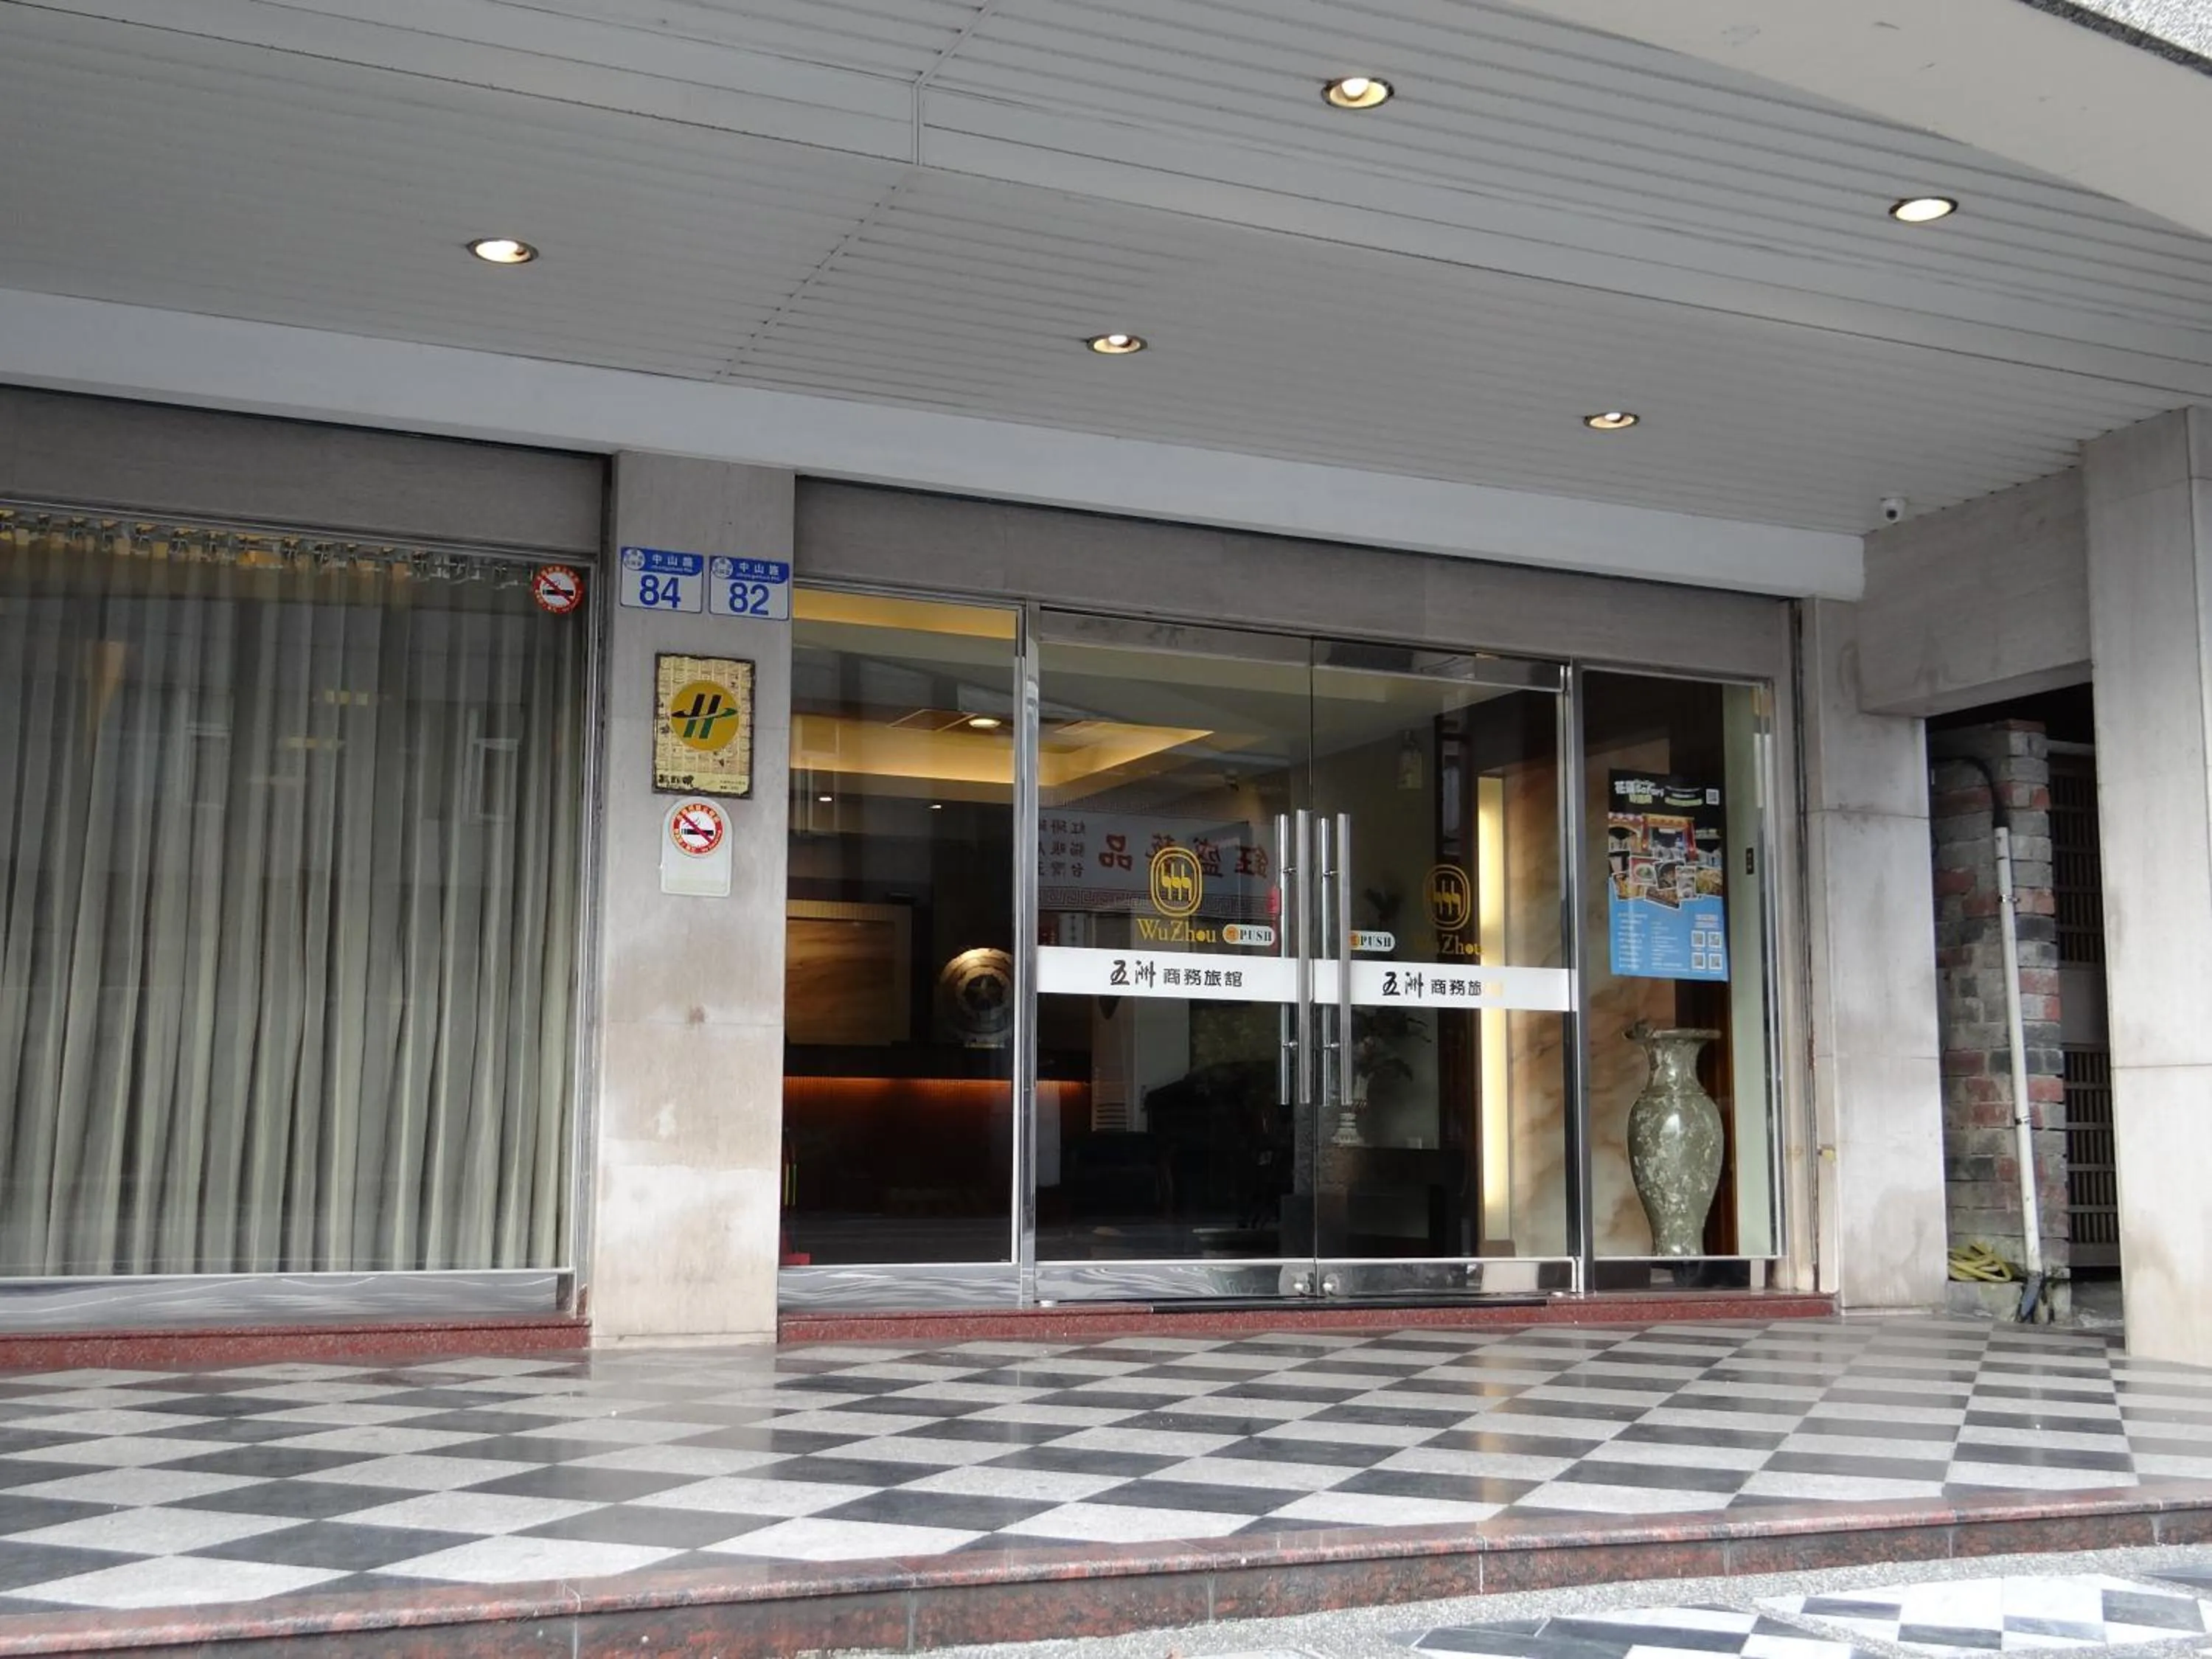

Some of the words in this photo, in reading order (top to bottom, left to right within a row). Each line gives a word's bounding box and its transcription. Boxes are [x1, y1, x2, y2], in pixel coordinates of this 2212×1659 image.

[652, 554, 693, 567] 中山路
[739, 561, 779, 575] 中山路
[639, 574, 681, 608] 84
[729, 582, 770, 615] 82
[1136, 918, 1216, 943] WuZhou
[1240, 928, 1272, 942] PUSH
[1360, 935, 1392, 947] PUSH
[1110, 959, 1157, 989] 五洲
[1163, 967, 1243, 987] 商務旅館
[1382, 971, 1425, 999] 五洲
[1430, 978, 1484, 996] 商務旅
